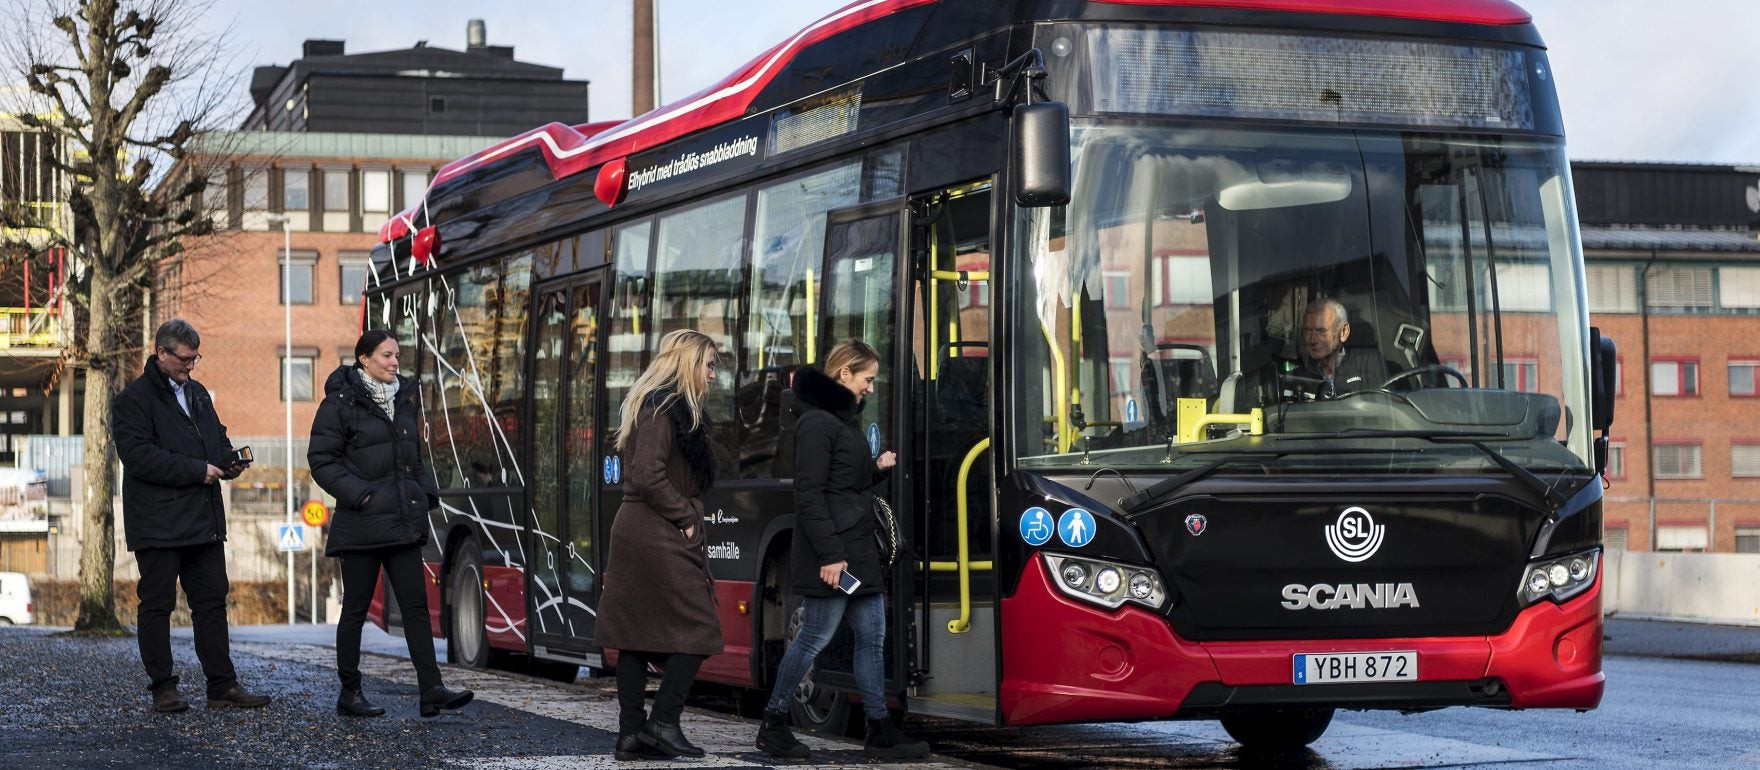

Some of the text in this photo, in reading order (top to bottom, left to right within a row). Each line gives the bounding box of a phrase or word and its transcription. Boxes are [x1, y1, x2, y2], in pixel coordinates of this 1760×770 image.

[627, 135, 758, 190] Elhybrid med trådlös snabbladdning
[307, 508, 324, 521] 50
[1342, 517, 1368, 538] SL
[708, 542, 740, 560] samhälle
[1281, 582, 1420, 611] SCANIA
[1314, 657, 1357, 679] YBH
[1365, 655, 1408, 678] 872
